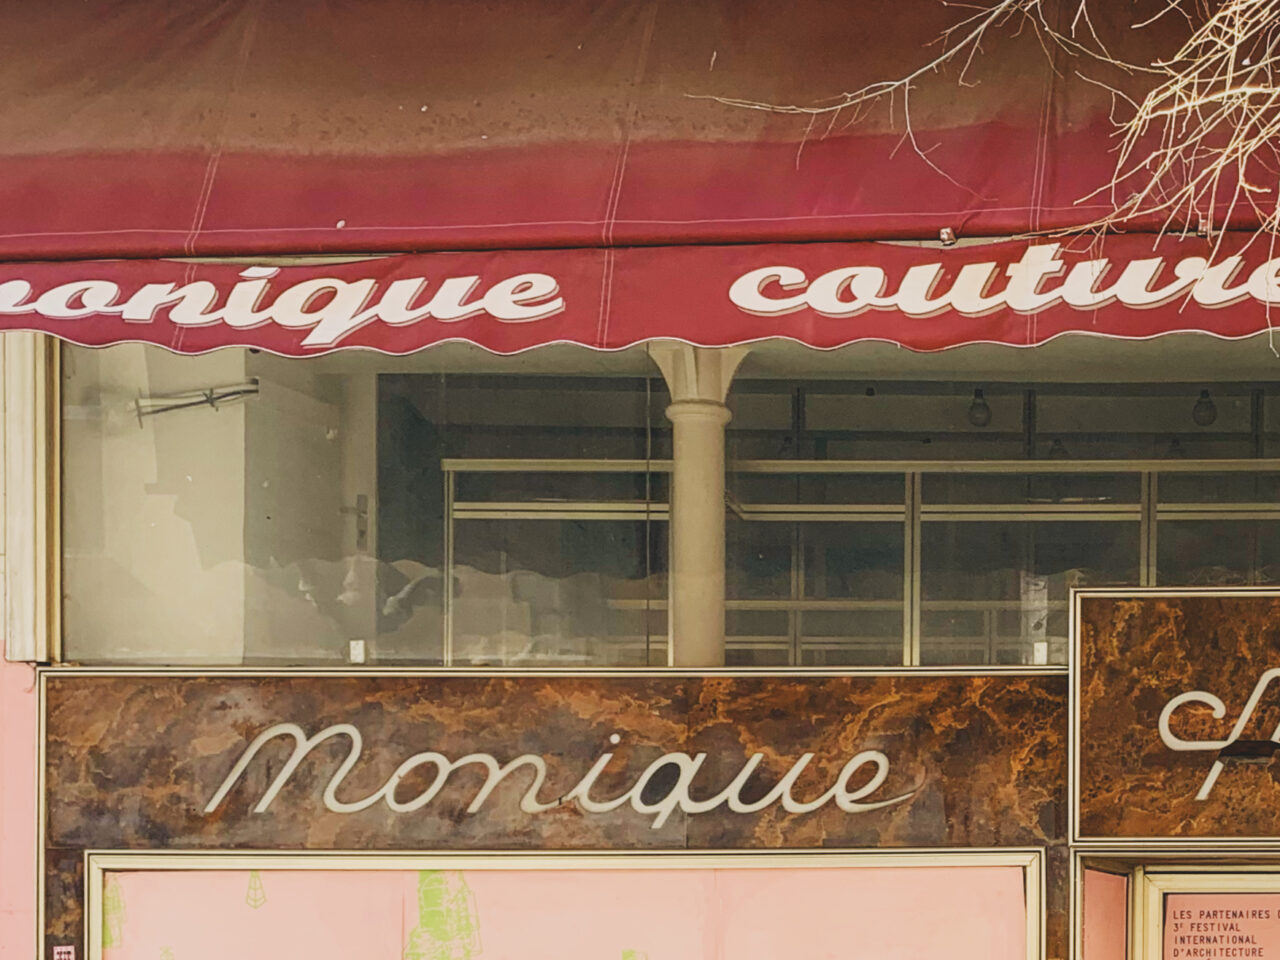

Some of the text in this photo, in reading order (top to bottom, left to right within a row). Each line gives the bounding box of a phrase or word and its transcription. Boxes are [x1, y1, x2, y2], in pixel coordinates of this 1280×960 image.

[0, 266, 566, 348] onique
[204, 723, 922, 829] Monique
[1173, 909, 1192, 920] LES
[1199, 909, 1271, 920] PARTENAIRES
[1190, 922, 1241, 932] FESTIVAL
[1174, 935, 1257, 945] INTERNATIONAL
[1173, 947, 1264, 957] D'ARCHITECTURE
